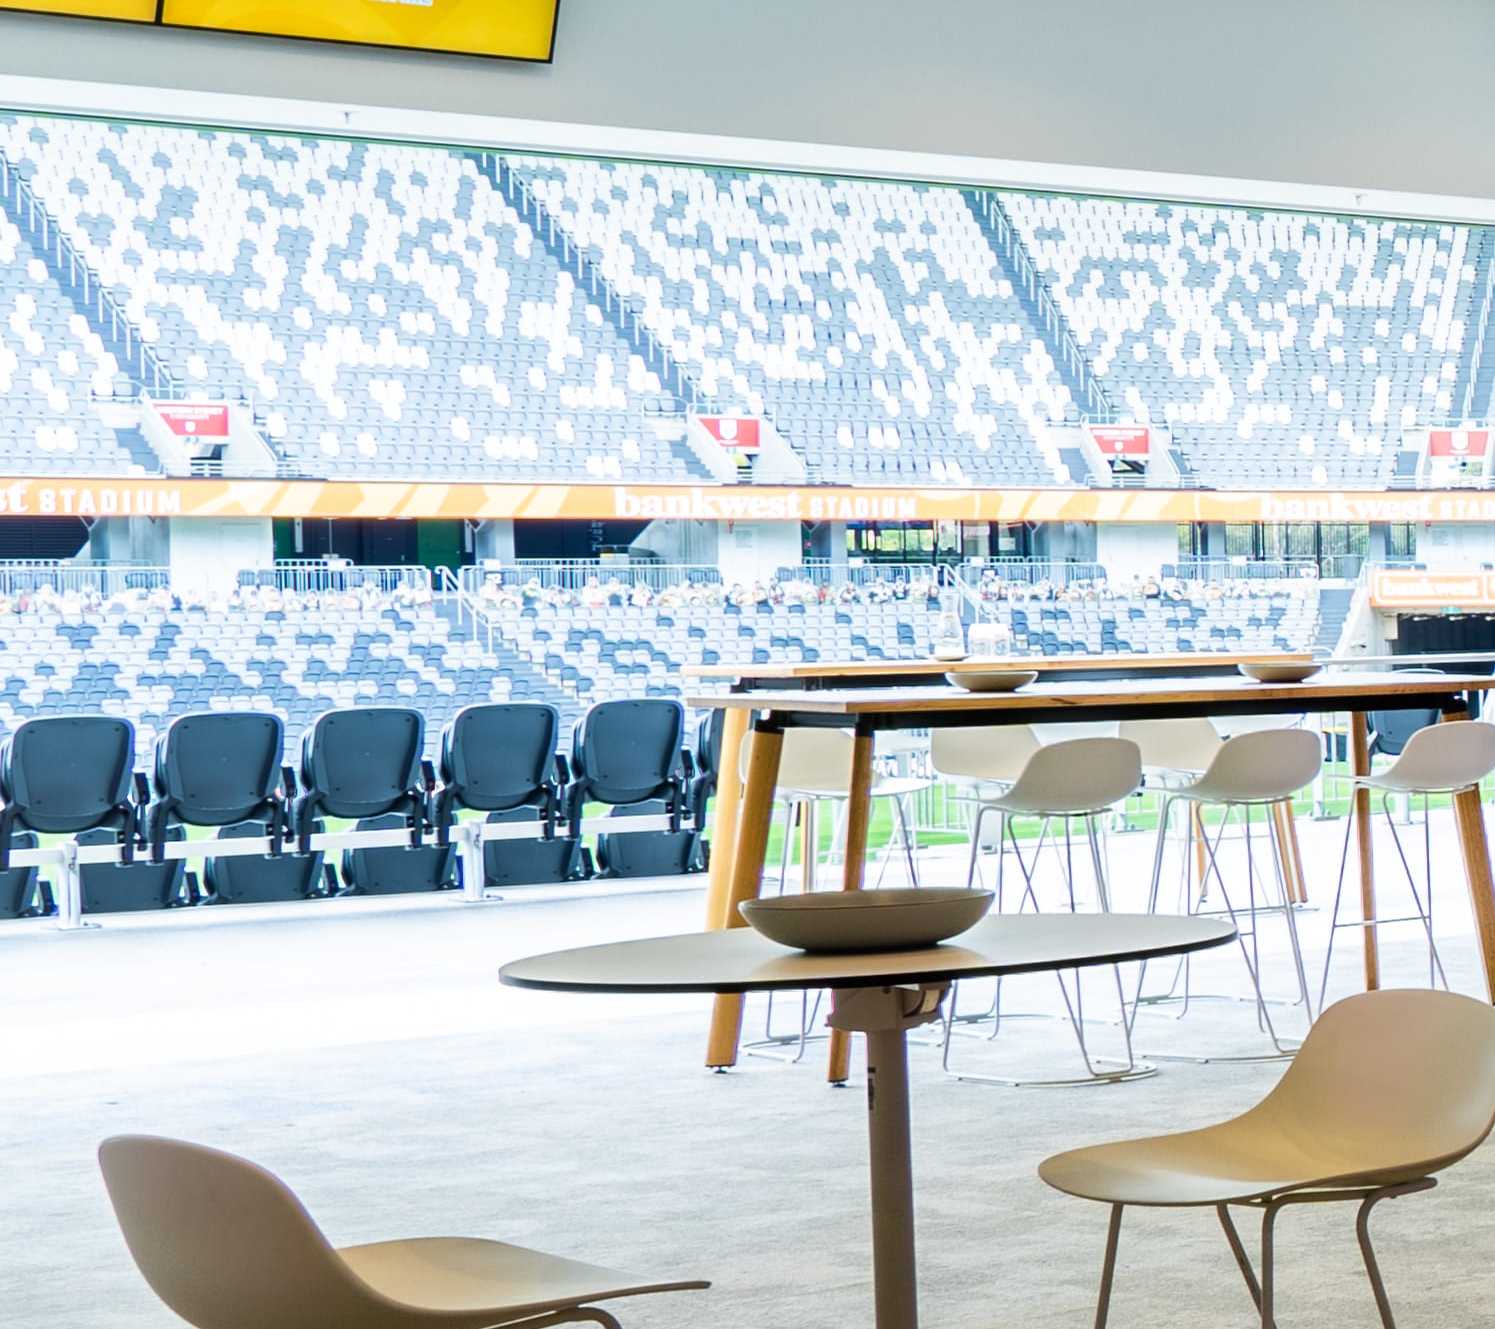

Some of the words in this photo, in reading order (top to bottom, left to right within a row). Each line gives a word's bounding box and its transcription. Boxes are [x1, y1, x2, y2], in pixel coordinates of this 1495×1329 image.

[38, 488, 182, 514] STADIUM
[618, 487, 802, 518] bankwest
[810, 497, 917, 518] STADIUM
[1264, 493, 1433, 520] bankwest
[1383, 578, 1479, 596] bankwest
